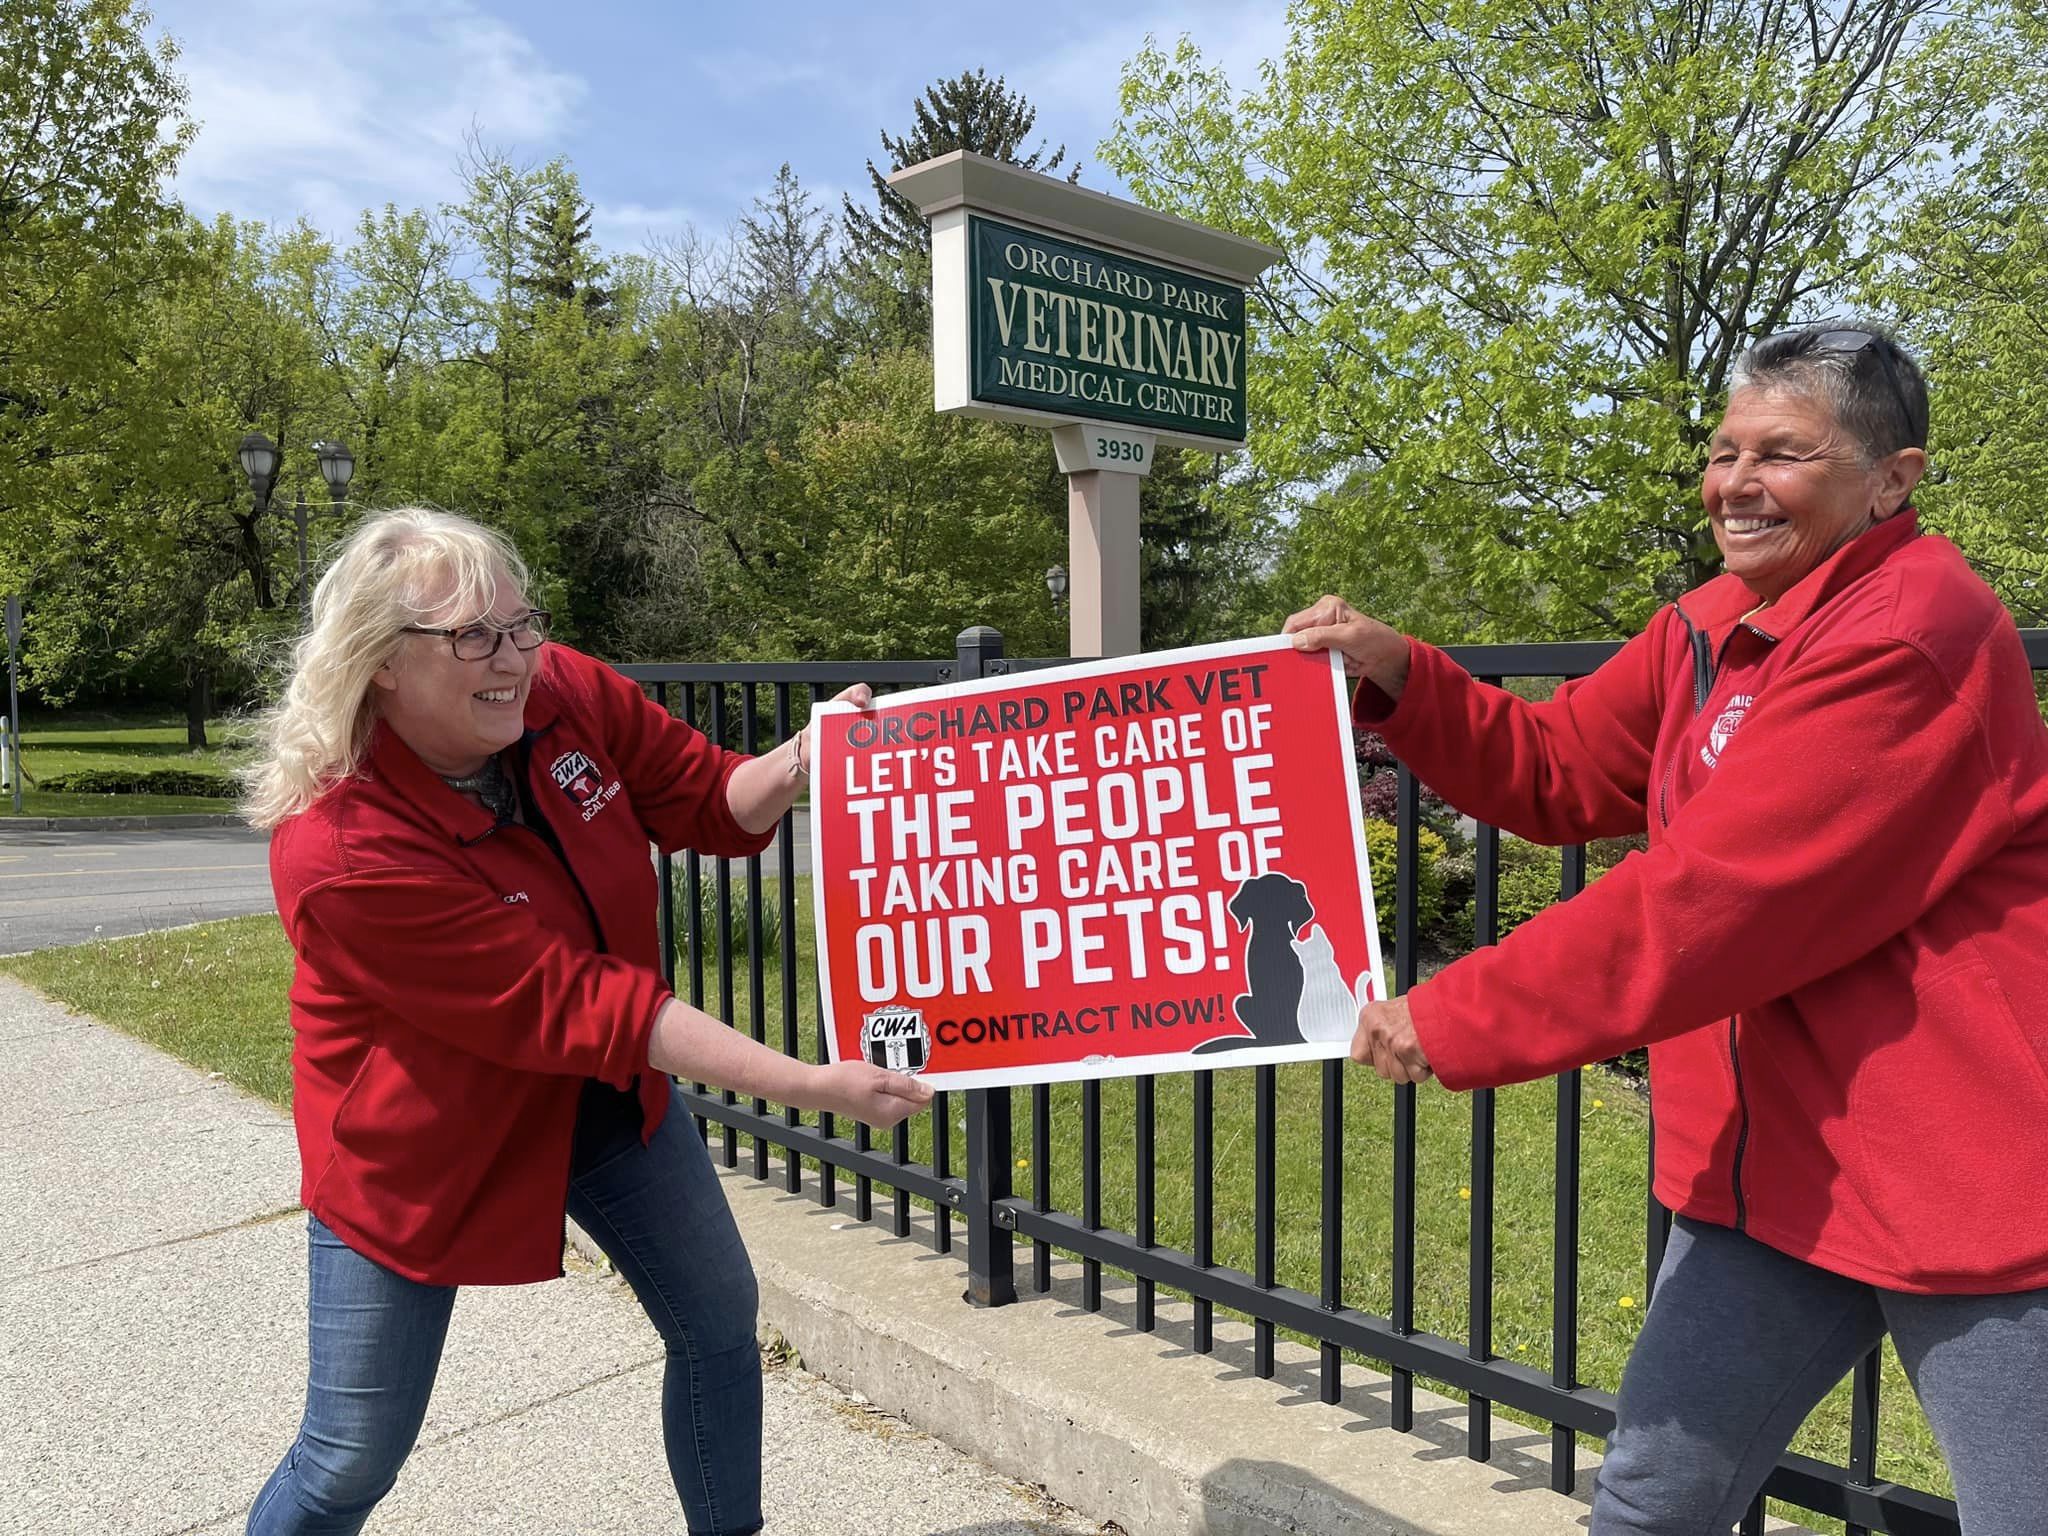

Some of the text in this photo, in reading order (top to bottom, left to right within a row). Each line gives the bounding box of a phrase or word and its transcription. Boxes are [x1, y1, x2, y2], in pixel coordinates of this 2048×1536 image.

[1004, 243, 1229, 321] ORCHARD PARK
[987, 277, 1242, 390] VETERINARY
[998, 356, 1236, 423] MEDICAL CENTER
[1096, 438, 1144, 462] 3930
[847, 664, 1269, 748] ORCHARD PARK VET
[554, 753, 586, 786] CWA
[845, 703, 1272, 795] LET'S TAKE CARE OF
[581, 780, 622, 822] OCAL 1168
[846, 753, 1281, 864] THE PEOPLE
[849, 825, 1284, 917] TAKING CARE OF
[854, 890, 1230, 1003] OUR PETS!
[871, 1015, 917, 1038] CWA
[935, 993, 1225, 1046] CONTRACT NOW!
